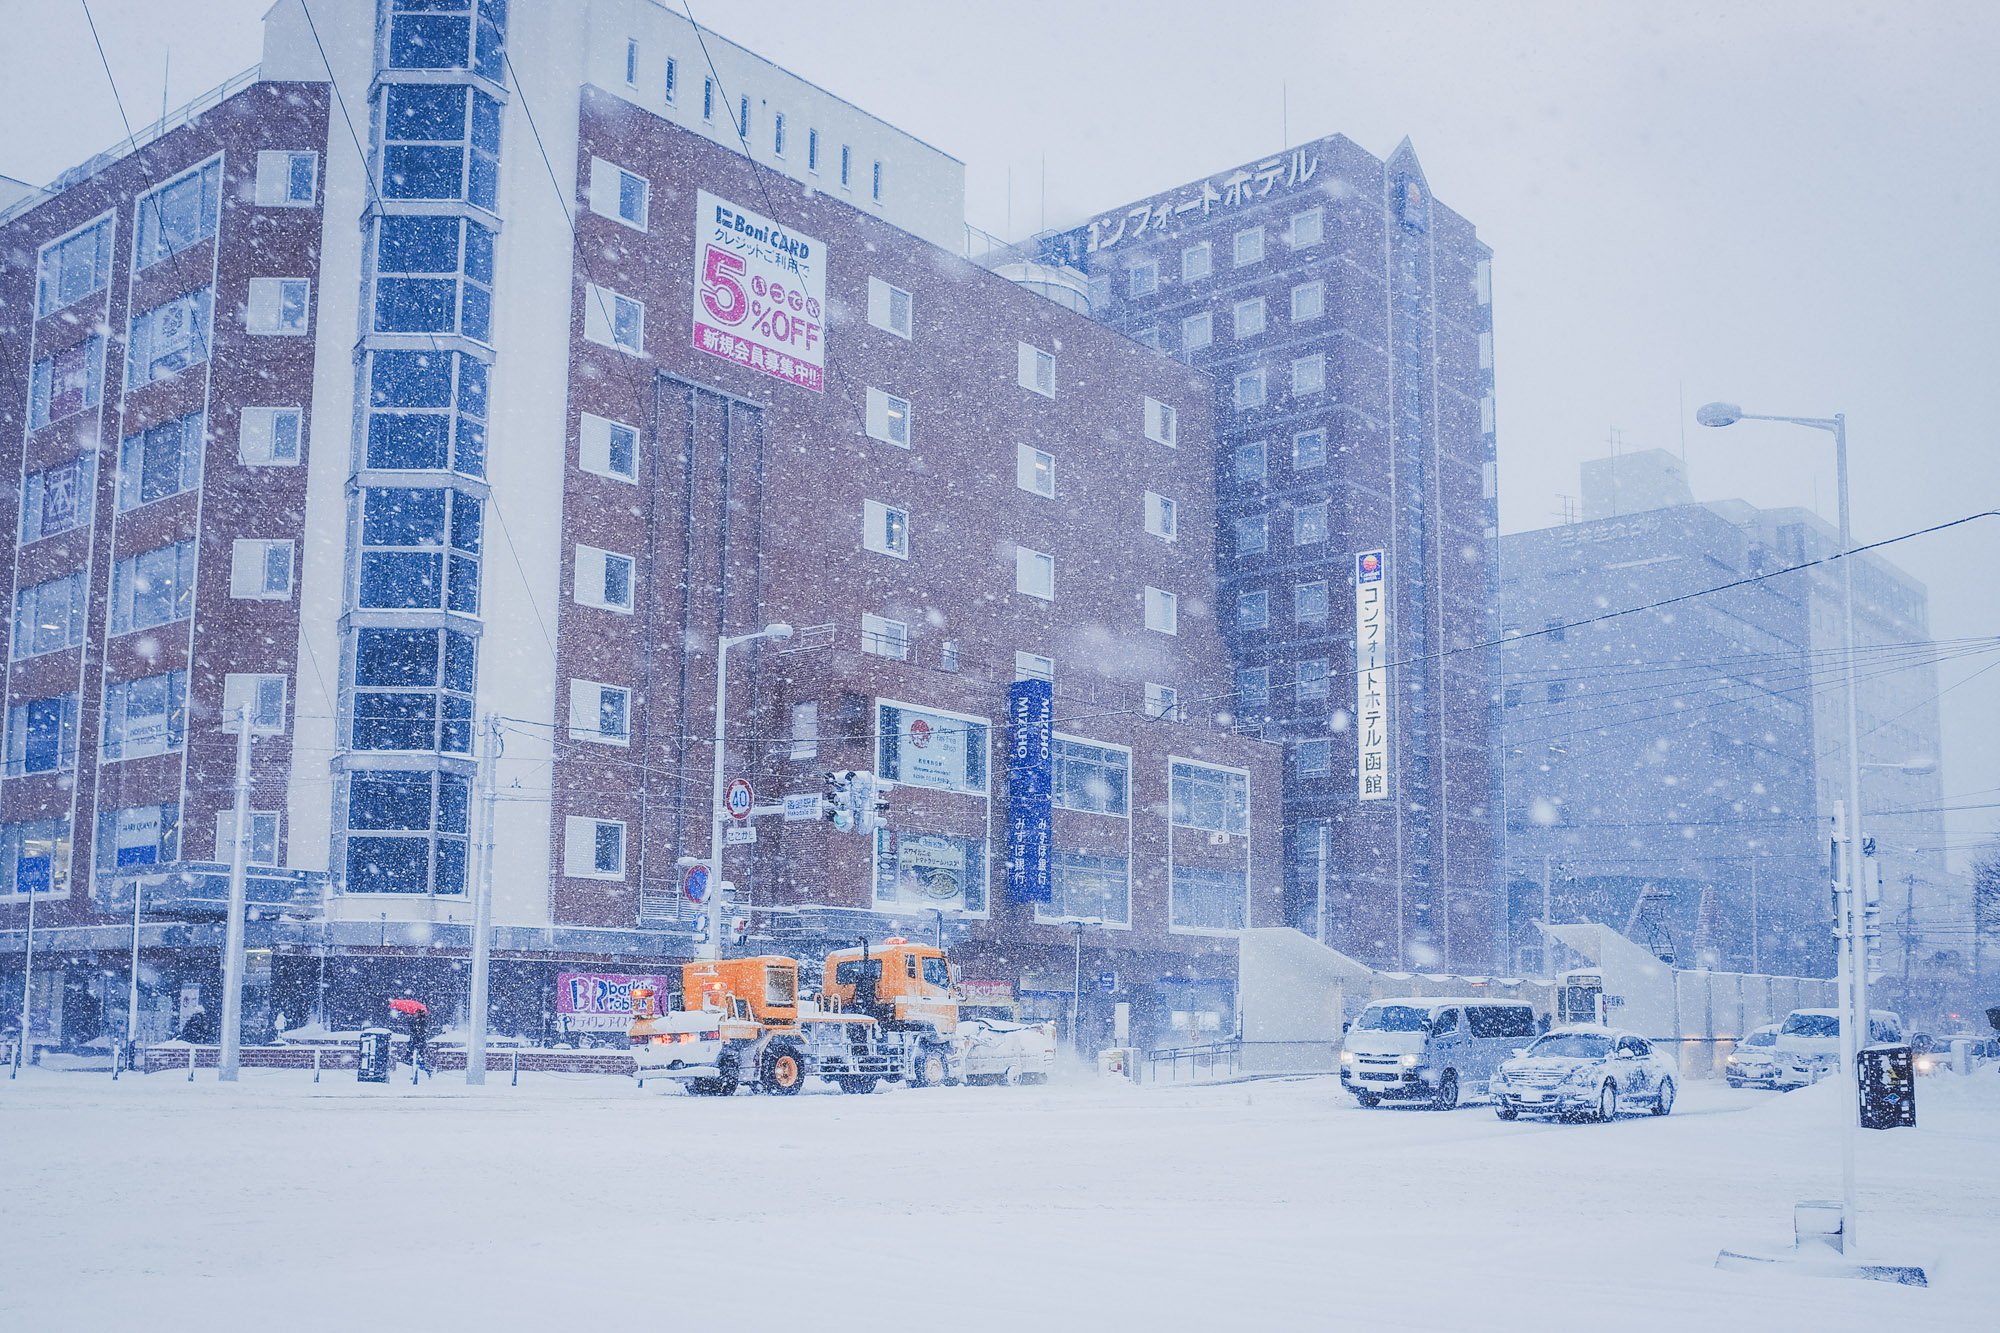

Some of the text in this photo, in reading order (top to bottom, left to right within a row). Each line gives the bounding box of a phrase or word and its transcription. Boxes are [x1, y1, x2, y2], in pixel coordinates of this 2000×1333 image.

[1086, 150, 1319, 253] コンフォートホテル
[714, 228, 810, 278] クレジットご利用で
[734, 214, 810, 260] Boni CARD
[703, 327, 817, 386] 新規会員募集中!!
[1363, 587, 1382, 794] コンフォートホテル函館
[1018, 697, 1029, 758] MIZUHO
[1040, 698, 1050, 759] MIZUHO
[732, 790, 747, 808] 40
[728, 831, 753, 841] ここから
[1014, 818, 1026, 885] みずほ銀行
[1038, 818, 1048, 885] みずほ銀行
